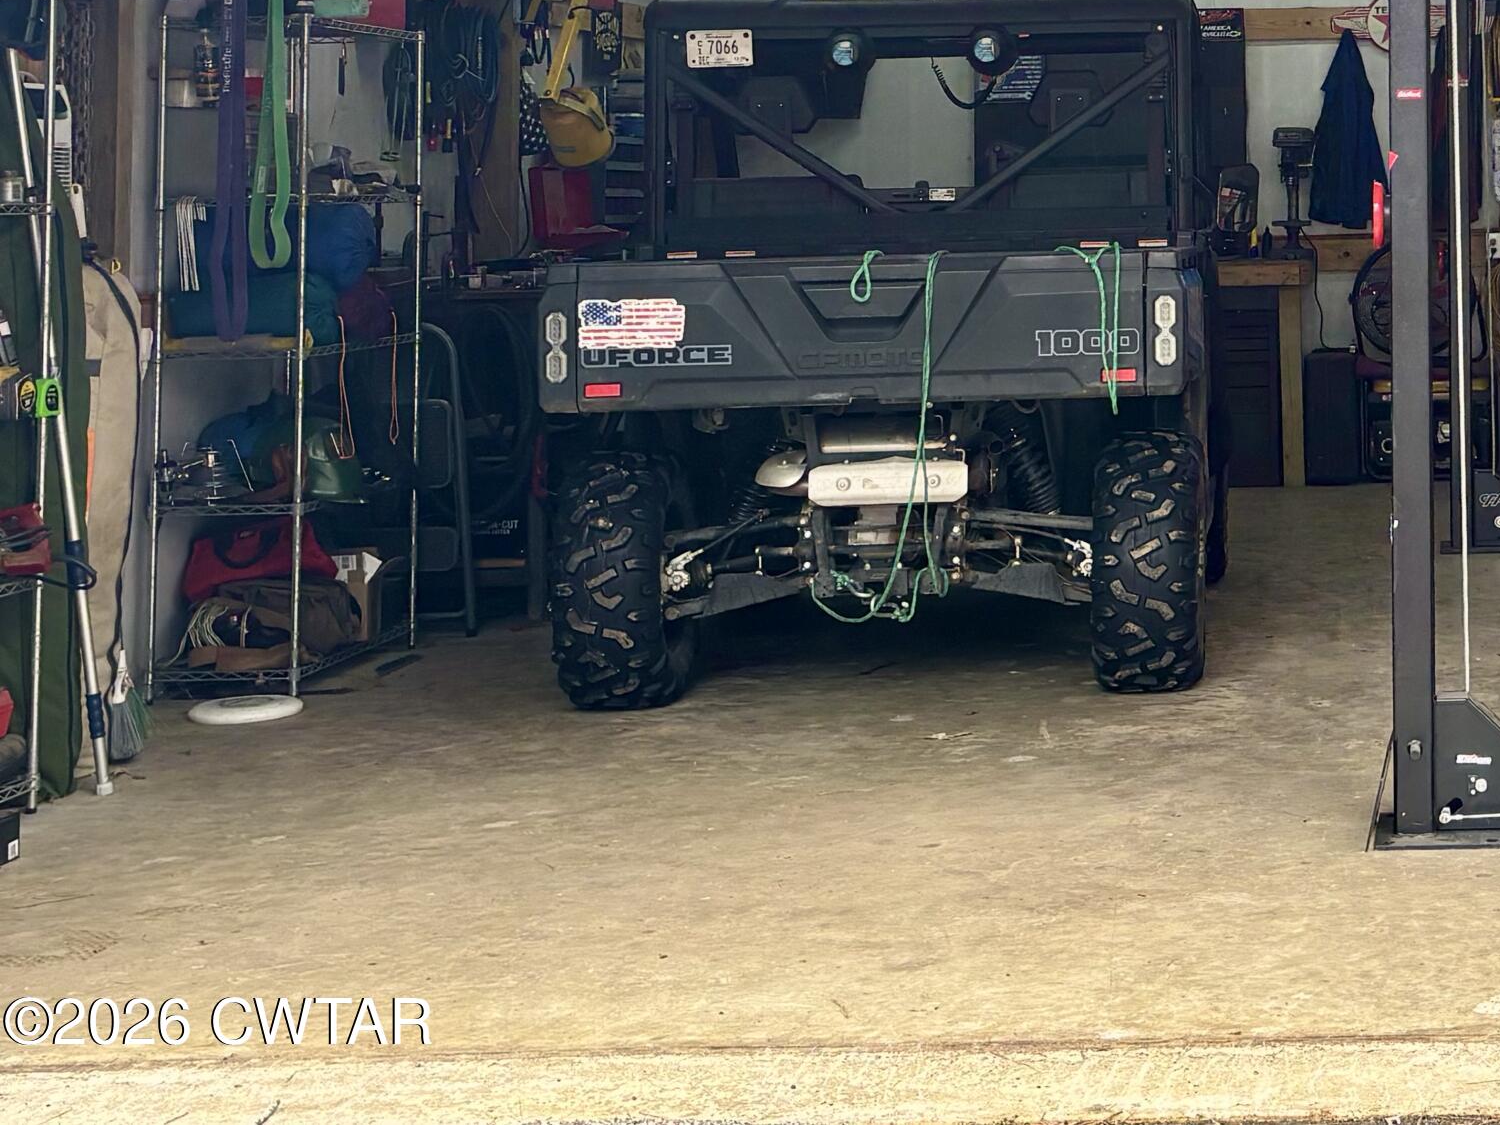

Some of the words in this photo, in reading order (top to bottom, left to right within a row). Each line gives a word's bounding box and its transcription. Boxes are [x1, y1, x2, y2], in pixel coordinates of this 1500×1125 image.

[707, 40, 738, 55] 7066
[1036, 328, 1140, 356] 1000
[581, 344, 732, 368] UFORCE
